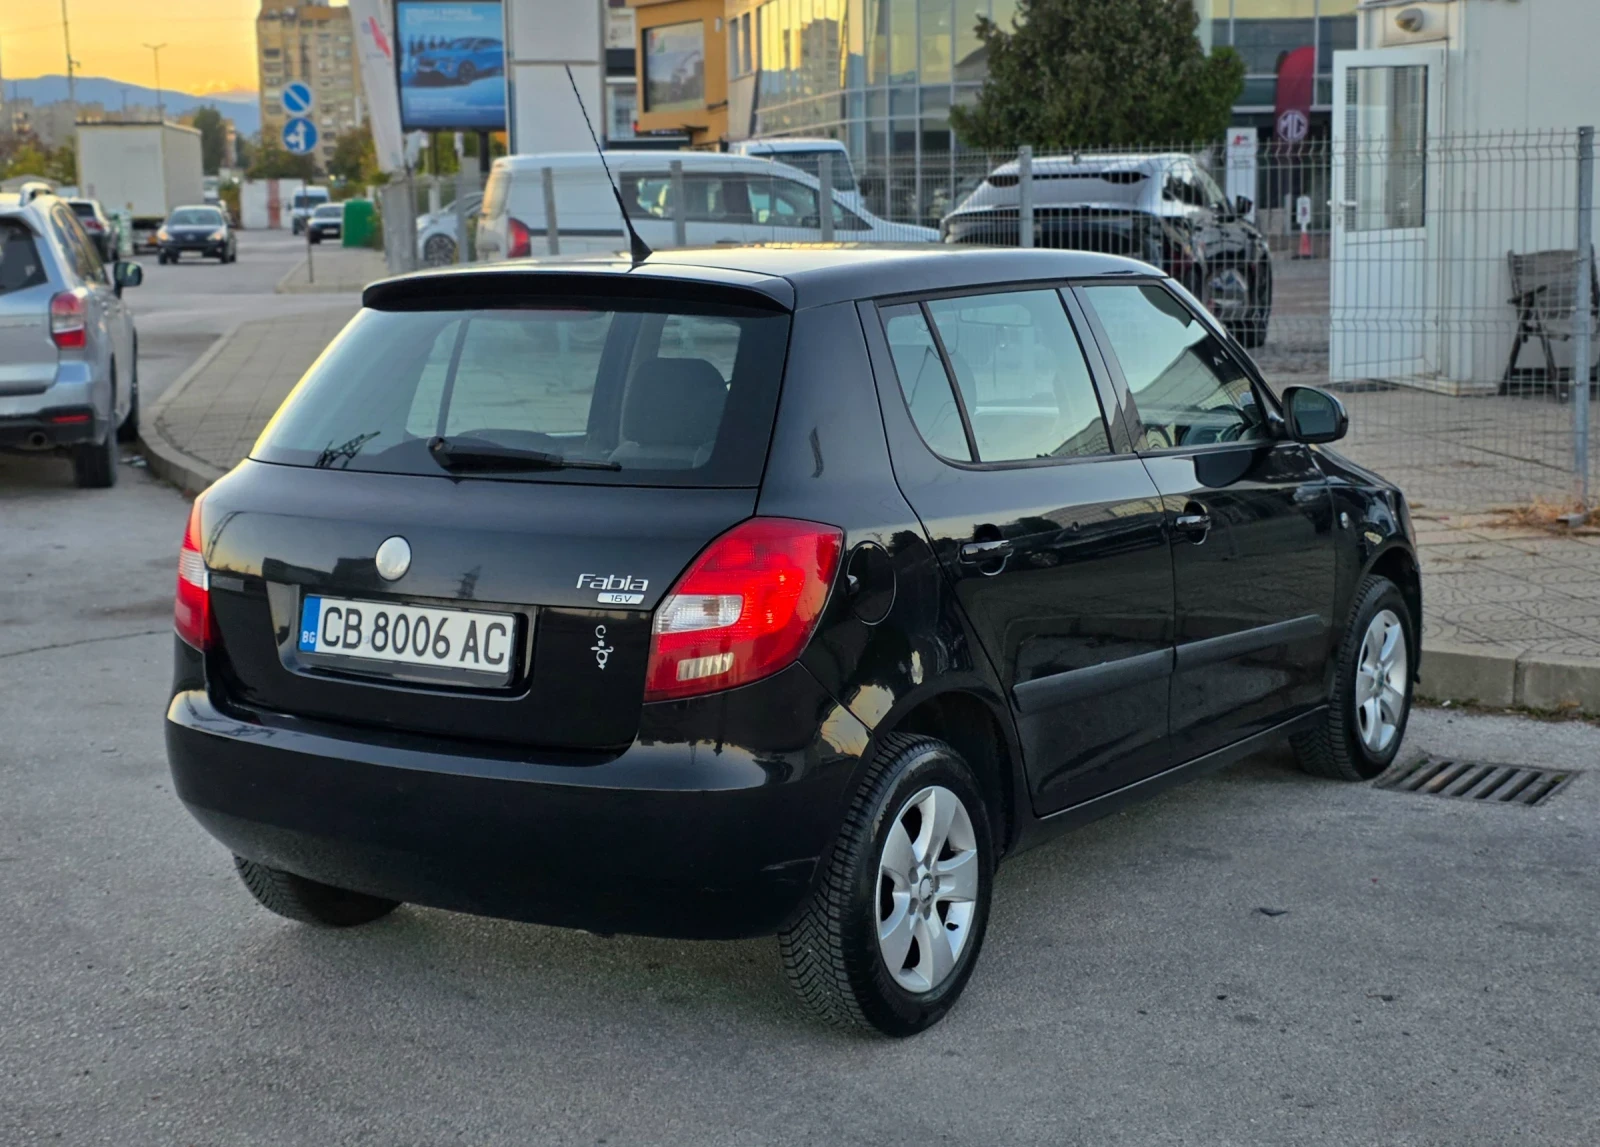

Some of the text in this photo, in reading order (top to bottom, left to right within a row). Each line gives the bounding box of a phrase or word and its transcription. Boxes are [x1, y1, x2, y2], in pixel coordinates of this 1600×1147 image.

[1279, 111, 1308, 141] MG
[576, 573, 649, 592] Fabia
[610, 594, 632, 603] 16V
[302, 606, 507, 666] BG CB 8006 AC
